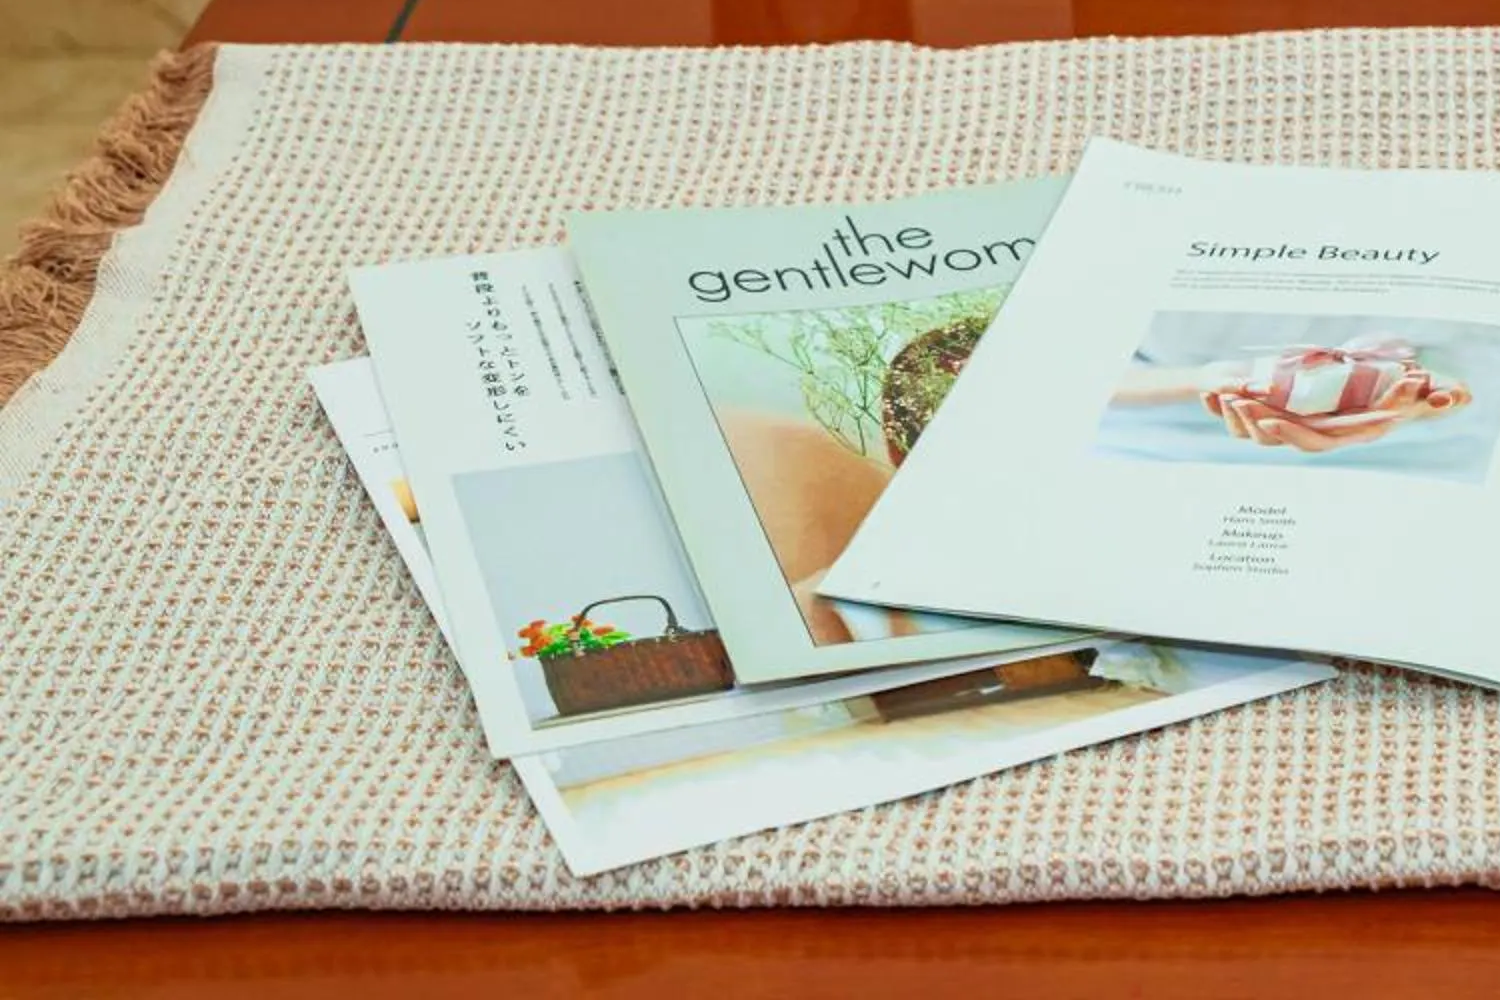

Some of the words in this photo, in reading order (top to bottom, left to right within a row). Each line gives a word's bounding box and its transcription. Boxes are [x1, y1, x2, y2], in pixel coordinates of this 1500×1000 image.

[835, 215, 934, 257] the
[1187, 241, 1307, 262] Simple
[1317, 244, 1440, 265] Beauty
